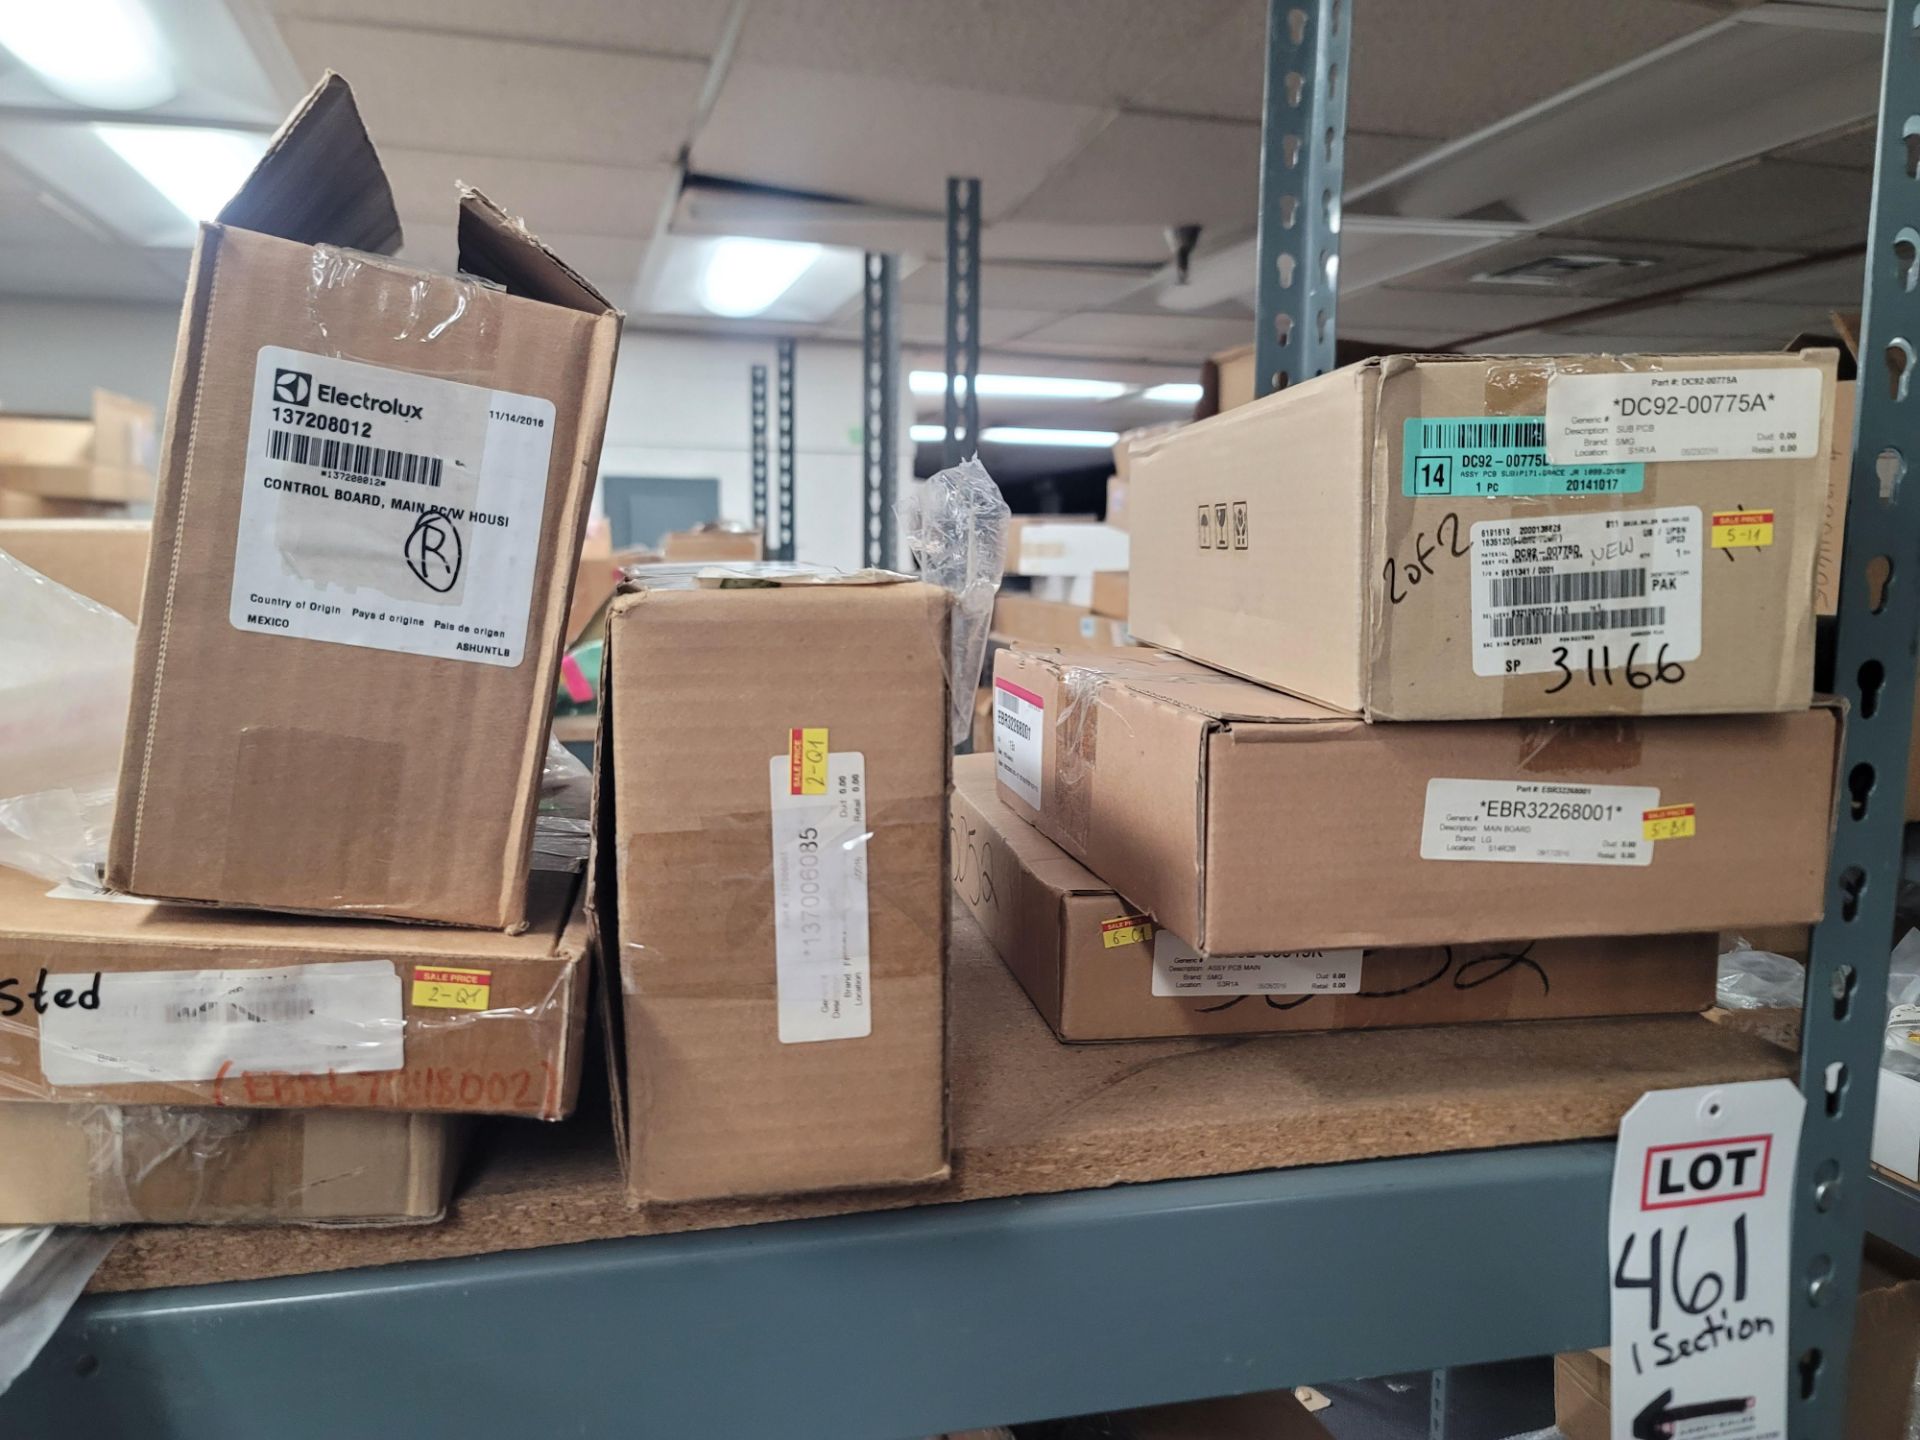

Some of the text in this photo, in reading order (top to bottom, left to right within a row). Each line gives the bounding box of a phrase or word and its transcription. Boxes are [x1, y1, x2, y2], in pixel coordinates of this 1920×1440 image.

[317, 383, 424, 420] Electrolux
[272, 406, 373, 438] 137208012
[1421, 464, 1445, 488] 14
[1476, 482, 1499, 492] 1 PC
[1566, 478, 1619, 491] 20141017
[263, 476, 329, 499] CONTROL
[334, 487, 385, 510] BOARD,
[390, 498, 425, 514] MAIN
[468, 511, 510, 528] HOUSI
[1652, 577, 1677, 591] PAK
[246, 613, 290, 629] MEXICO
[250, 593, 292, 609] Country
[309, 601, 341, 615] Origin
[389, 614, 425, 626] origine
[458, 624, 471, 634] de
[456, 641, 511, 658] ASHUNTLB
[1505, 659, 1521, 673] SP
[1544, 642, 1686, 694] 31166
[423, 972, 479, 984] SALE PRICE
[1658, 1149, 1758, 1196] LOT
[1614, 1212, 1748, 1331] 461
[1654, 1308, 1775, 1367] Section
